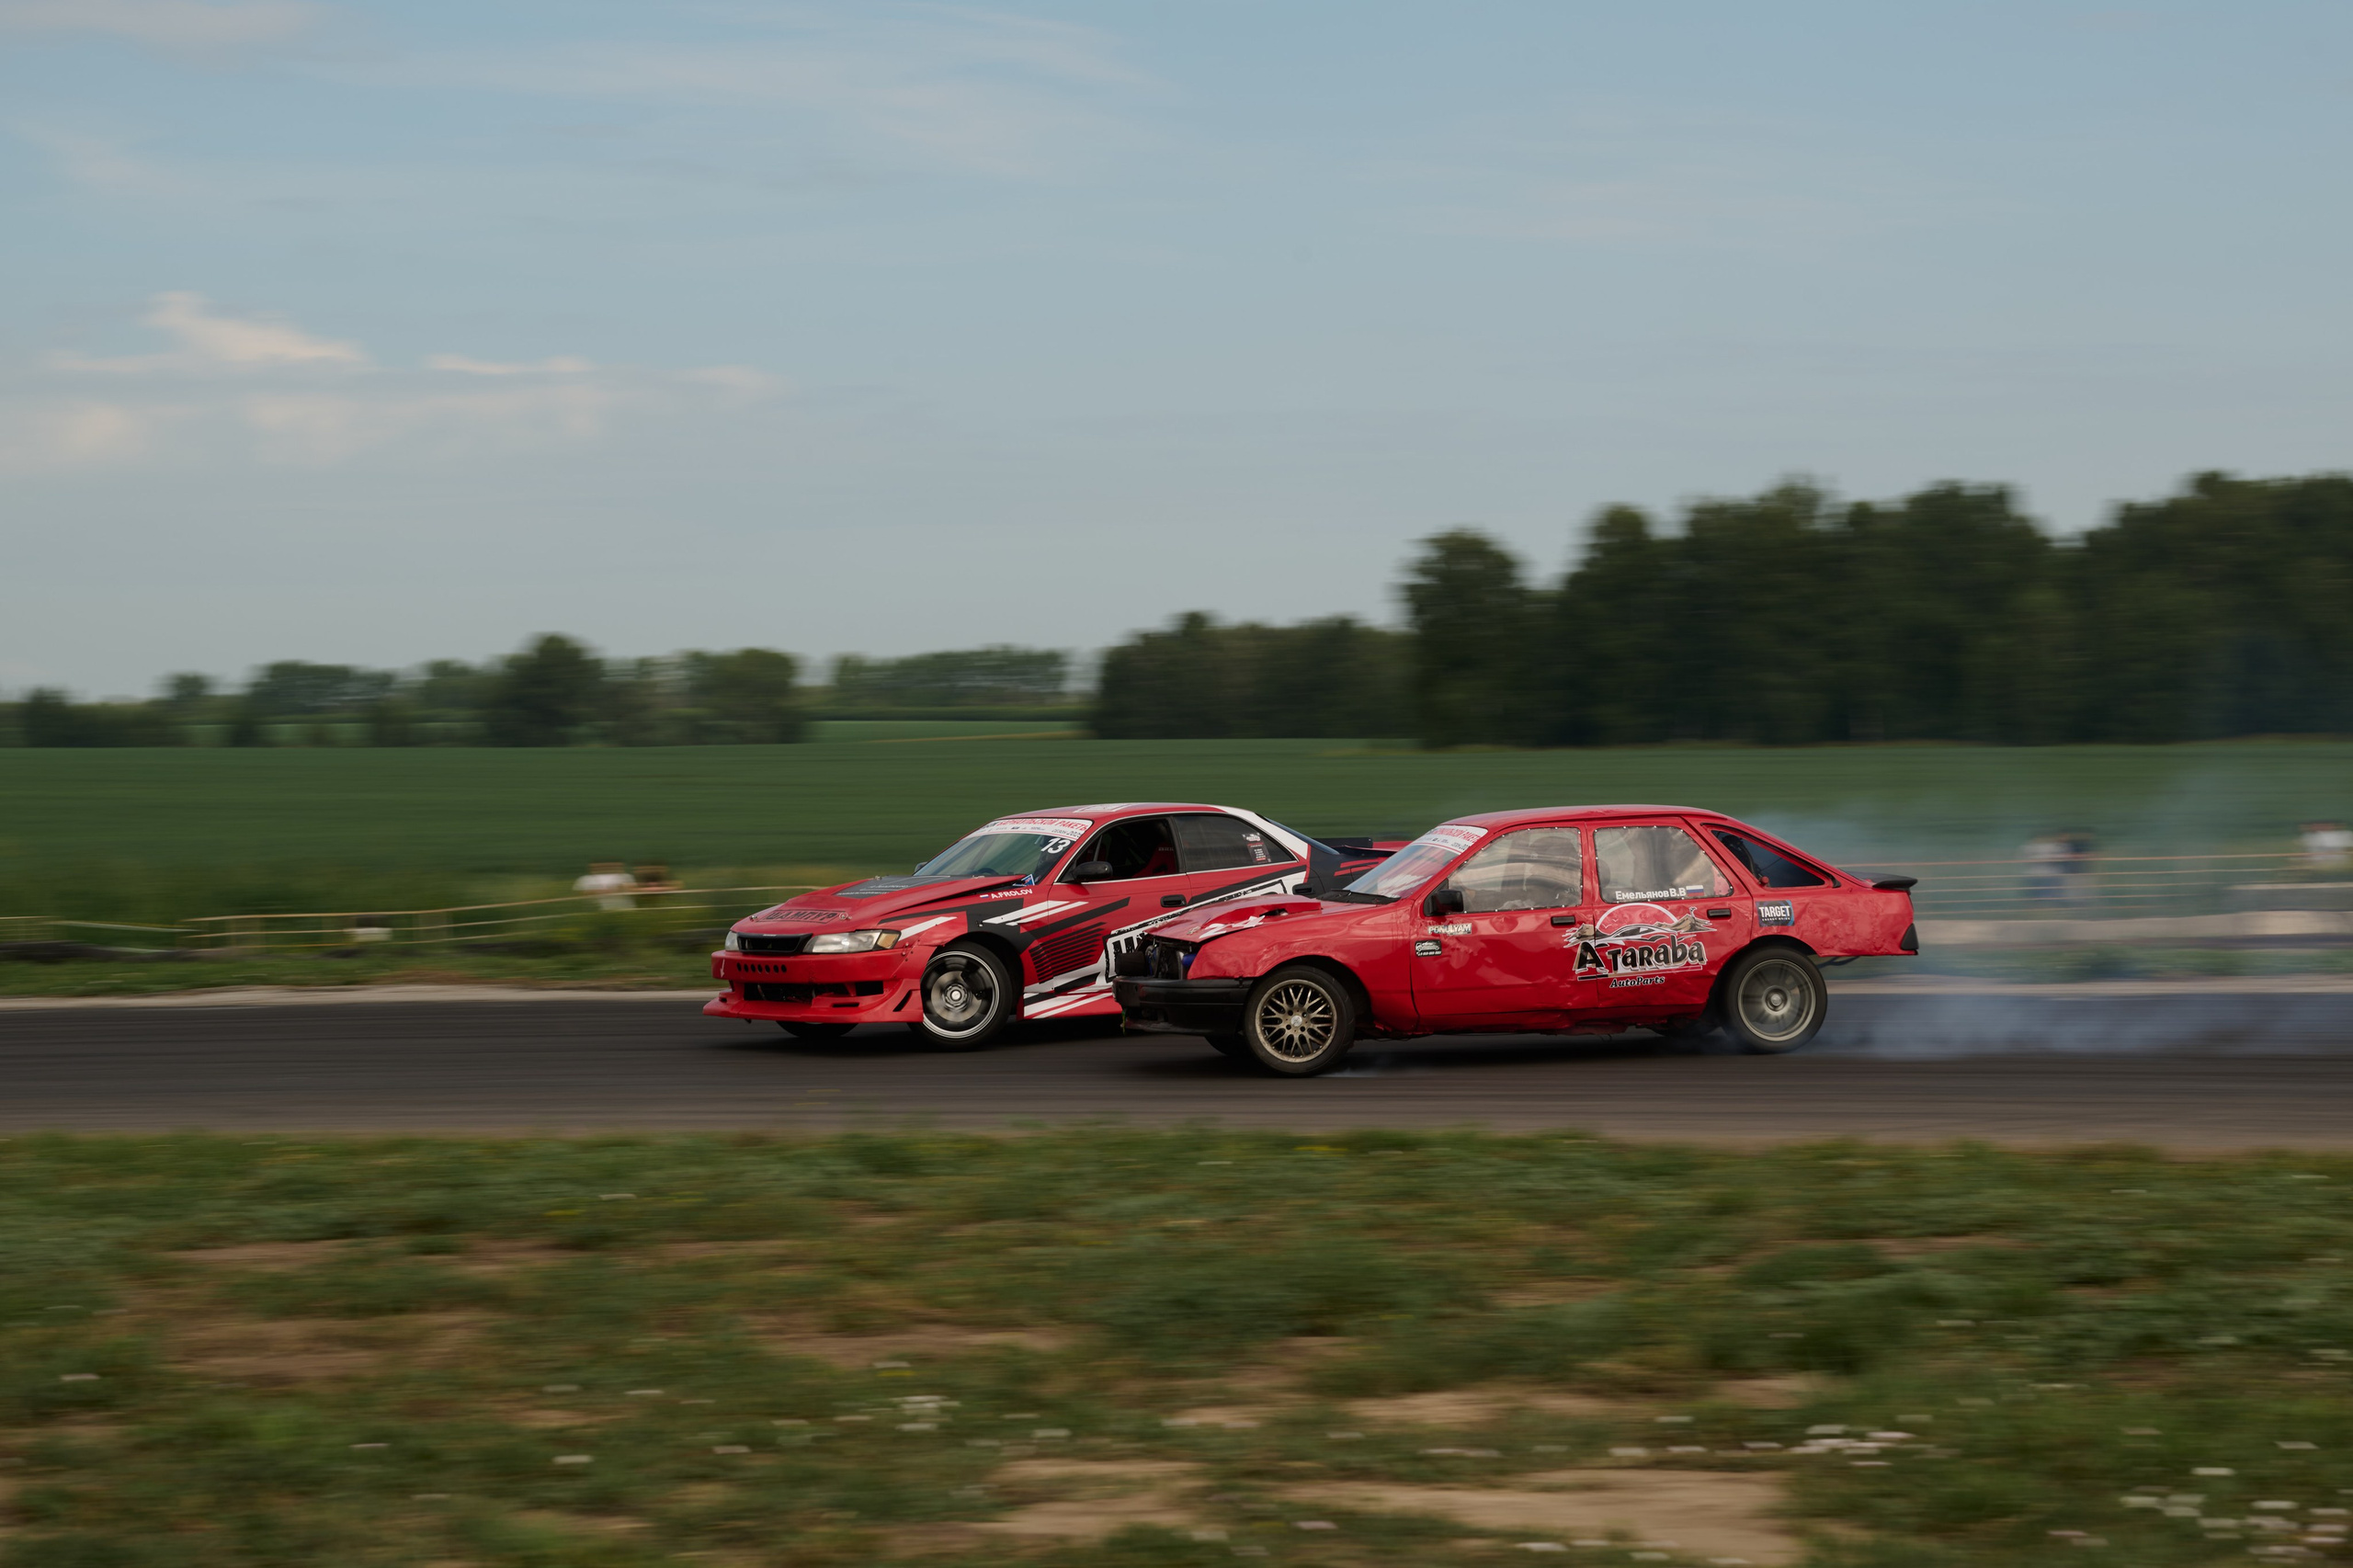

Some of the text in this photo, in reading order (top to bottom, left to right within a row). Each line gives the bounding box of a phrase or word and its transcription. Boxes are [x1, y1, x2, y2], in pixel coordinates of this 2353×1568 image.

[1040, 837, 1071, 854] 13
[991, 888, 1033, 899] A.FROLOV
[1615, 890, 1669, 901] Емельянов
[766, 911, 838, 922] ШАМПУР
[1758, 905, 1790, 918] TARGET
[1609, 975, 1665, 989] AutoParts
